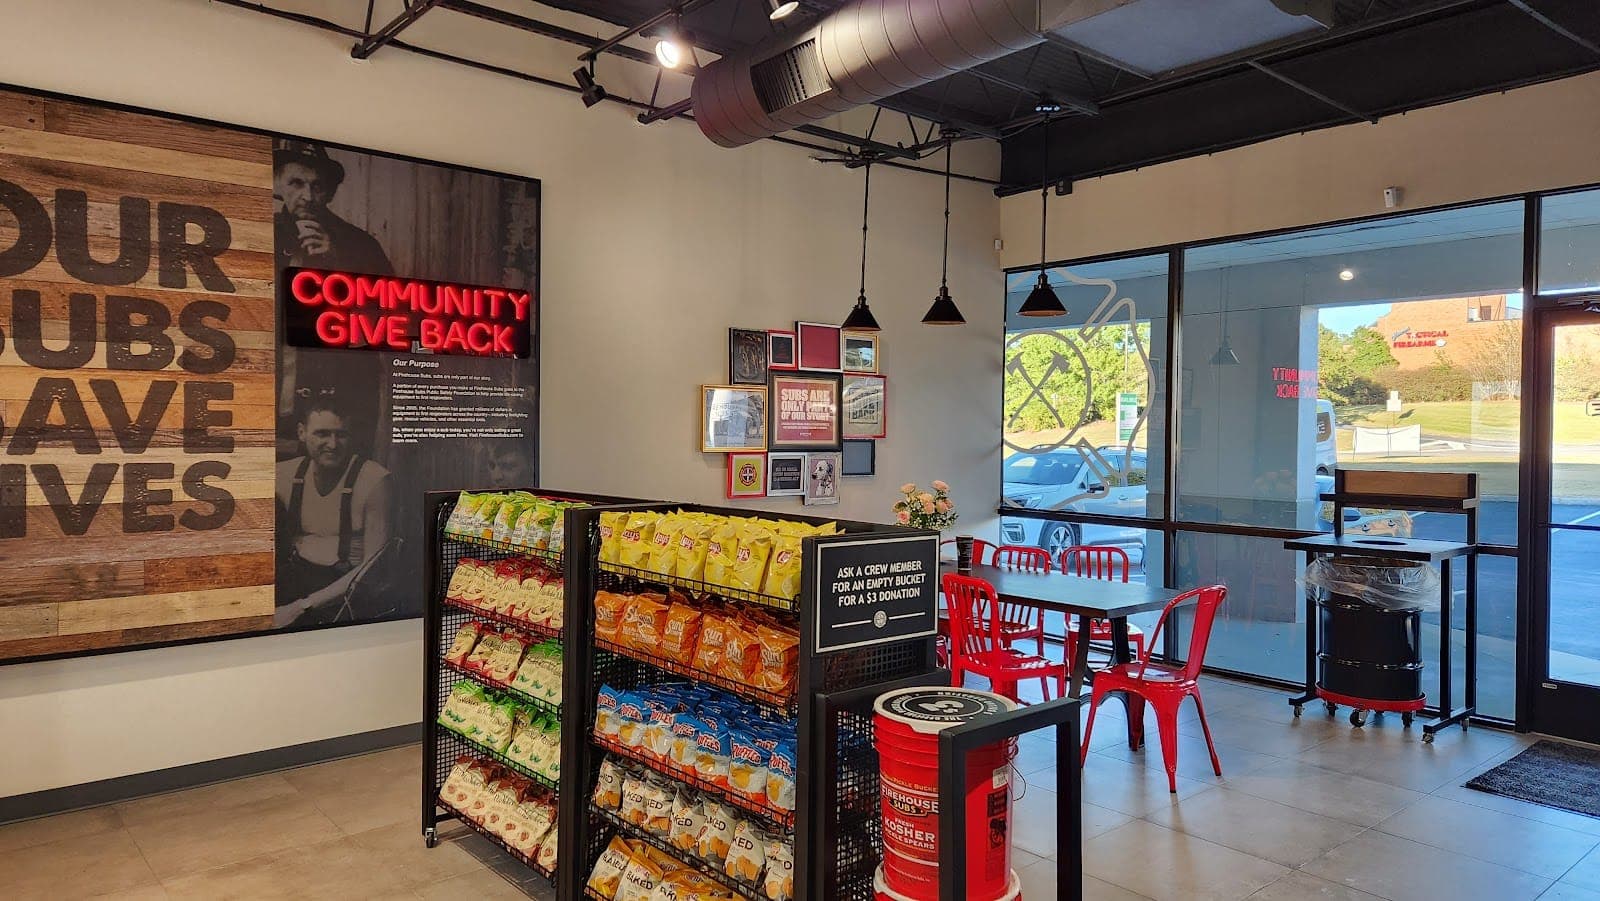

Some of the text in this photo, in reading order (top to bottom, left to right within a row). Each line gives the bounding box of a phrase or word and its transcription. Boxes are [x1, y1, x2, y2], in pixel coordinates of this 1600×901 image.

[291, 271, 530, 320] COMMUNITY
[0, 289, 236, 374] UBS
[316, 311, 514, 353] GIVE BACK
[1406, 330, 1449, 339] TCTICAL
[393, 358, 440, 368] Our Purpose
[781, 388, 830, 401] SUBS ARE
[781, 400, 805, 412] ONLY
[0, 377, 234, 455] AVE
[781, 411, 791, 420] OF
[791, 412, 806, 421] OUR
[0, 460, 235, 539] IVES
[837, 560, 922, 579] ASK A CREW MEMBER
[832, 573, 927, 594] FOR AN EMPTY BUCKET
[838, 587, 921, 607] FOR A $3 DONATION
[914, 783, 938, 793] BUCKE
[881, 784, 939, 814] FIREHOUSE
[893, 799, 917, 814] SUBS
[884, 816, 936, 843] KOSHER
[894, 817, 915, 828] FRESH
[904, 837, 936, 850] SPEARS
[626, 870, 654, 890] BAKED
